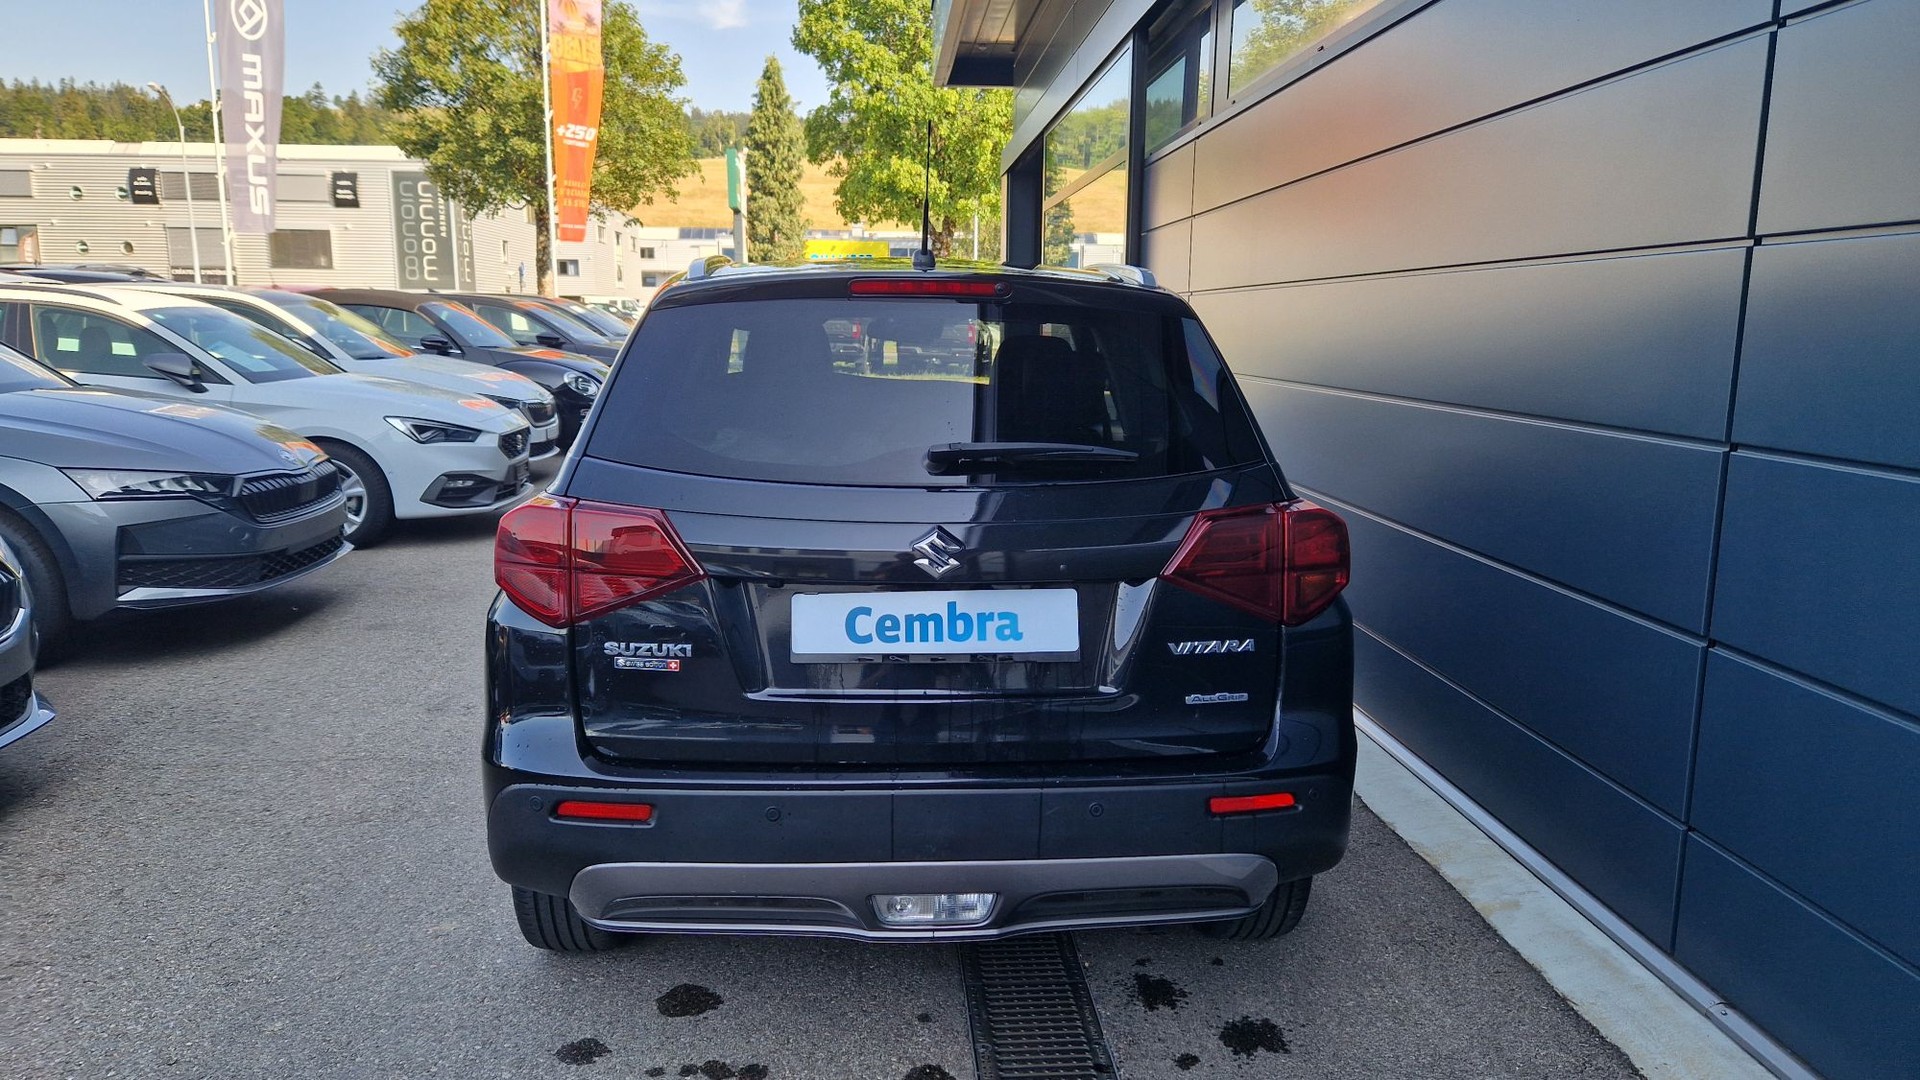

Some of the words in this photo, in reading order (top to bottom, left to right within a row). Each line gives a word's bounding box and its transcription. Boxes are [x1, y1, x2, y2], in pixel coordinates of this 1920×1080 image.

[242, 53, 270, 215] MAXUS
[556, 123, 597, 142] +250
[844, 601, 1024, 645] Cembra
[603, 641, 692, 657] SUZUKI
[1167, 639, 1255, 655] VITARA
